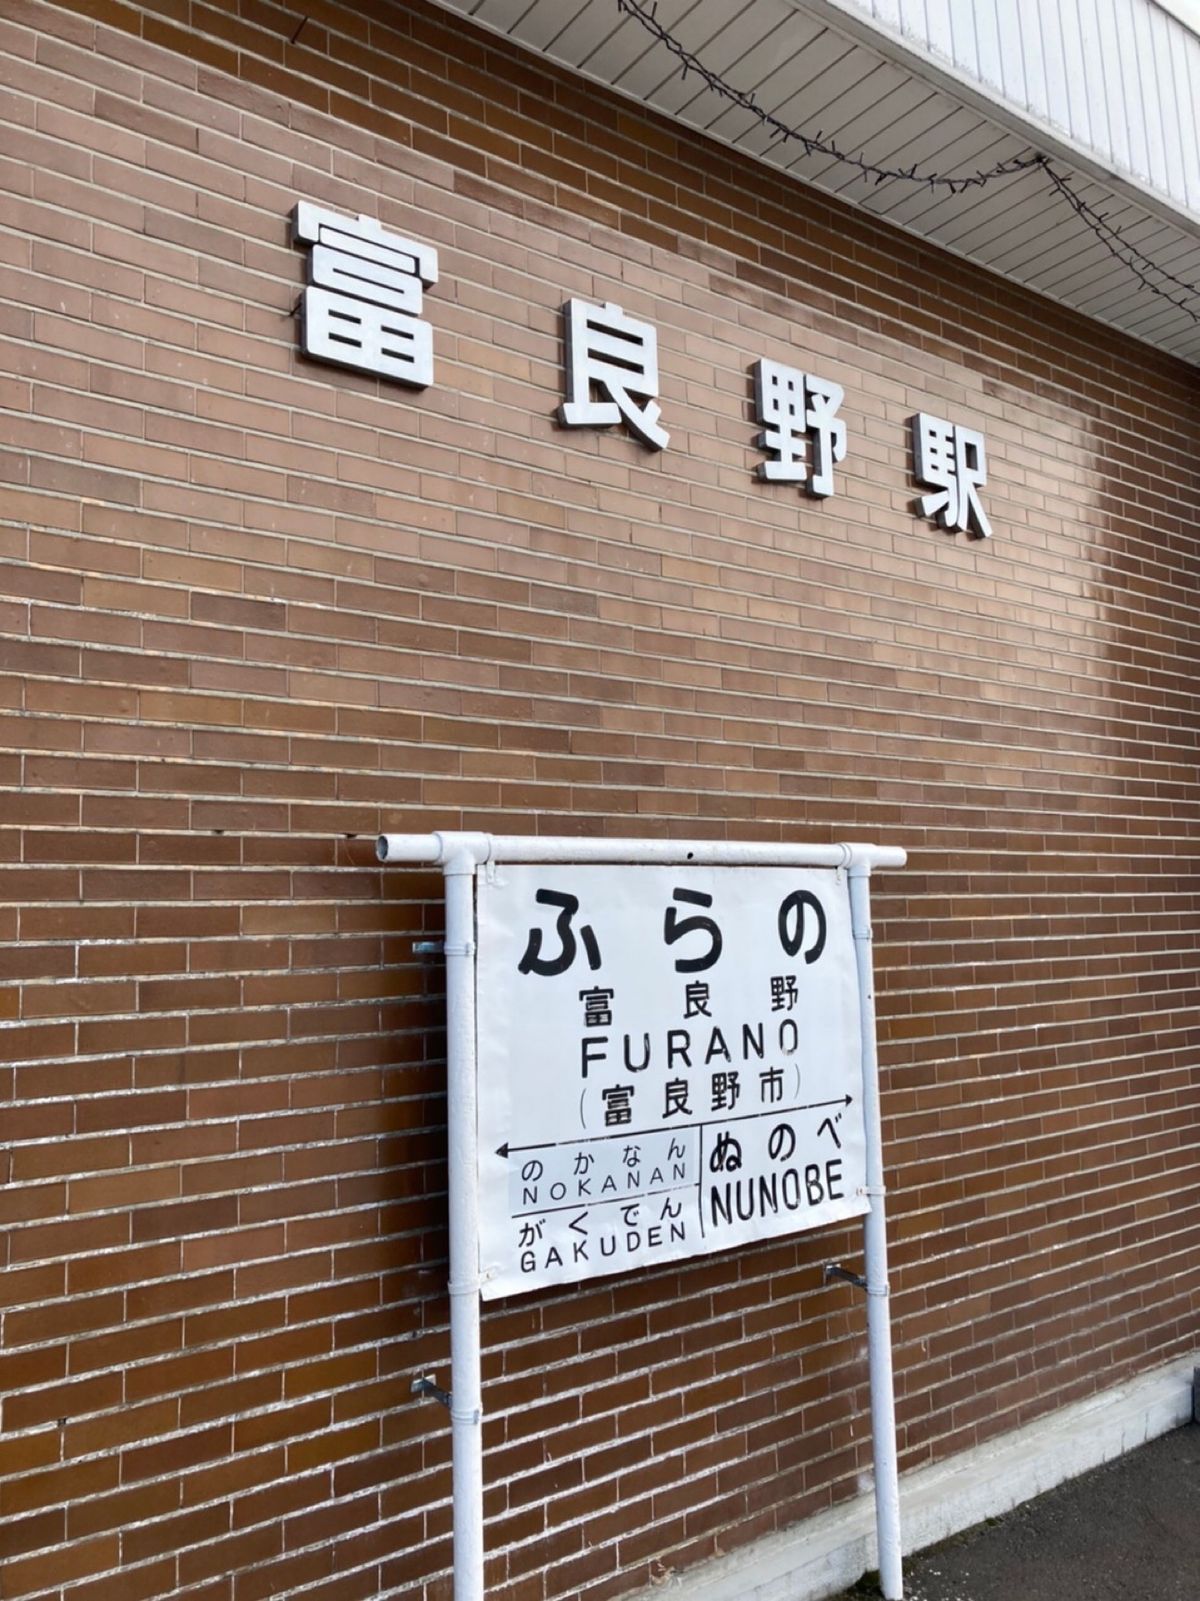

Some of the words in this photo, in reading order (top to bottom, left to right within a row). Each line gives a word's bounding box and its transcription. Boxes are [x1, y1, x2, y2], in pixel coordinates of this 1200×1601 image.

[293, 201, 993, 539] 富良野駅
[517, 887, 827, 977] ふらの
[579, 975, 798, 1028] 富良野
[581, 1018, 799, 1078] FURANO
[579, 1064, 801, 1129] (富良野市)
[521, 1137, 686, 1181] のかなん
[709, 1113, 843, 1173] ぬのべ
[522, 1163, 686, 1205] NOKANAN
[710, 1159, 844, 1227] NUNOBE
[517, 1197, 682, 1249] がくでん
[520, 1222, 686, 1274] GAKUDEN
